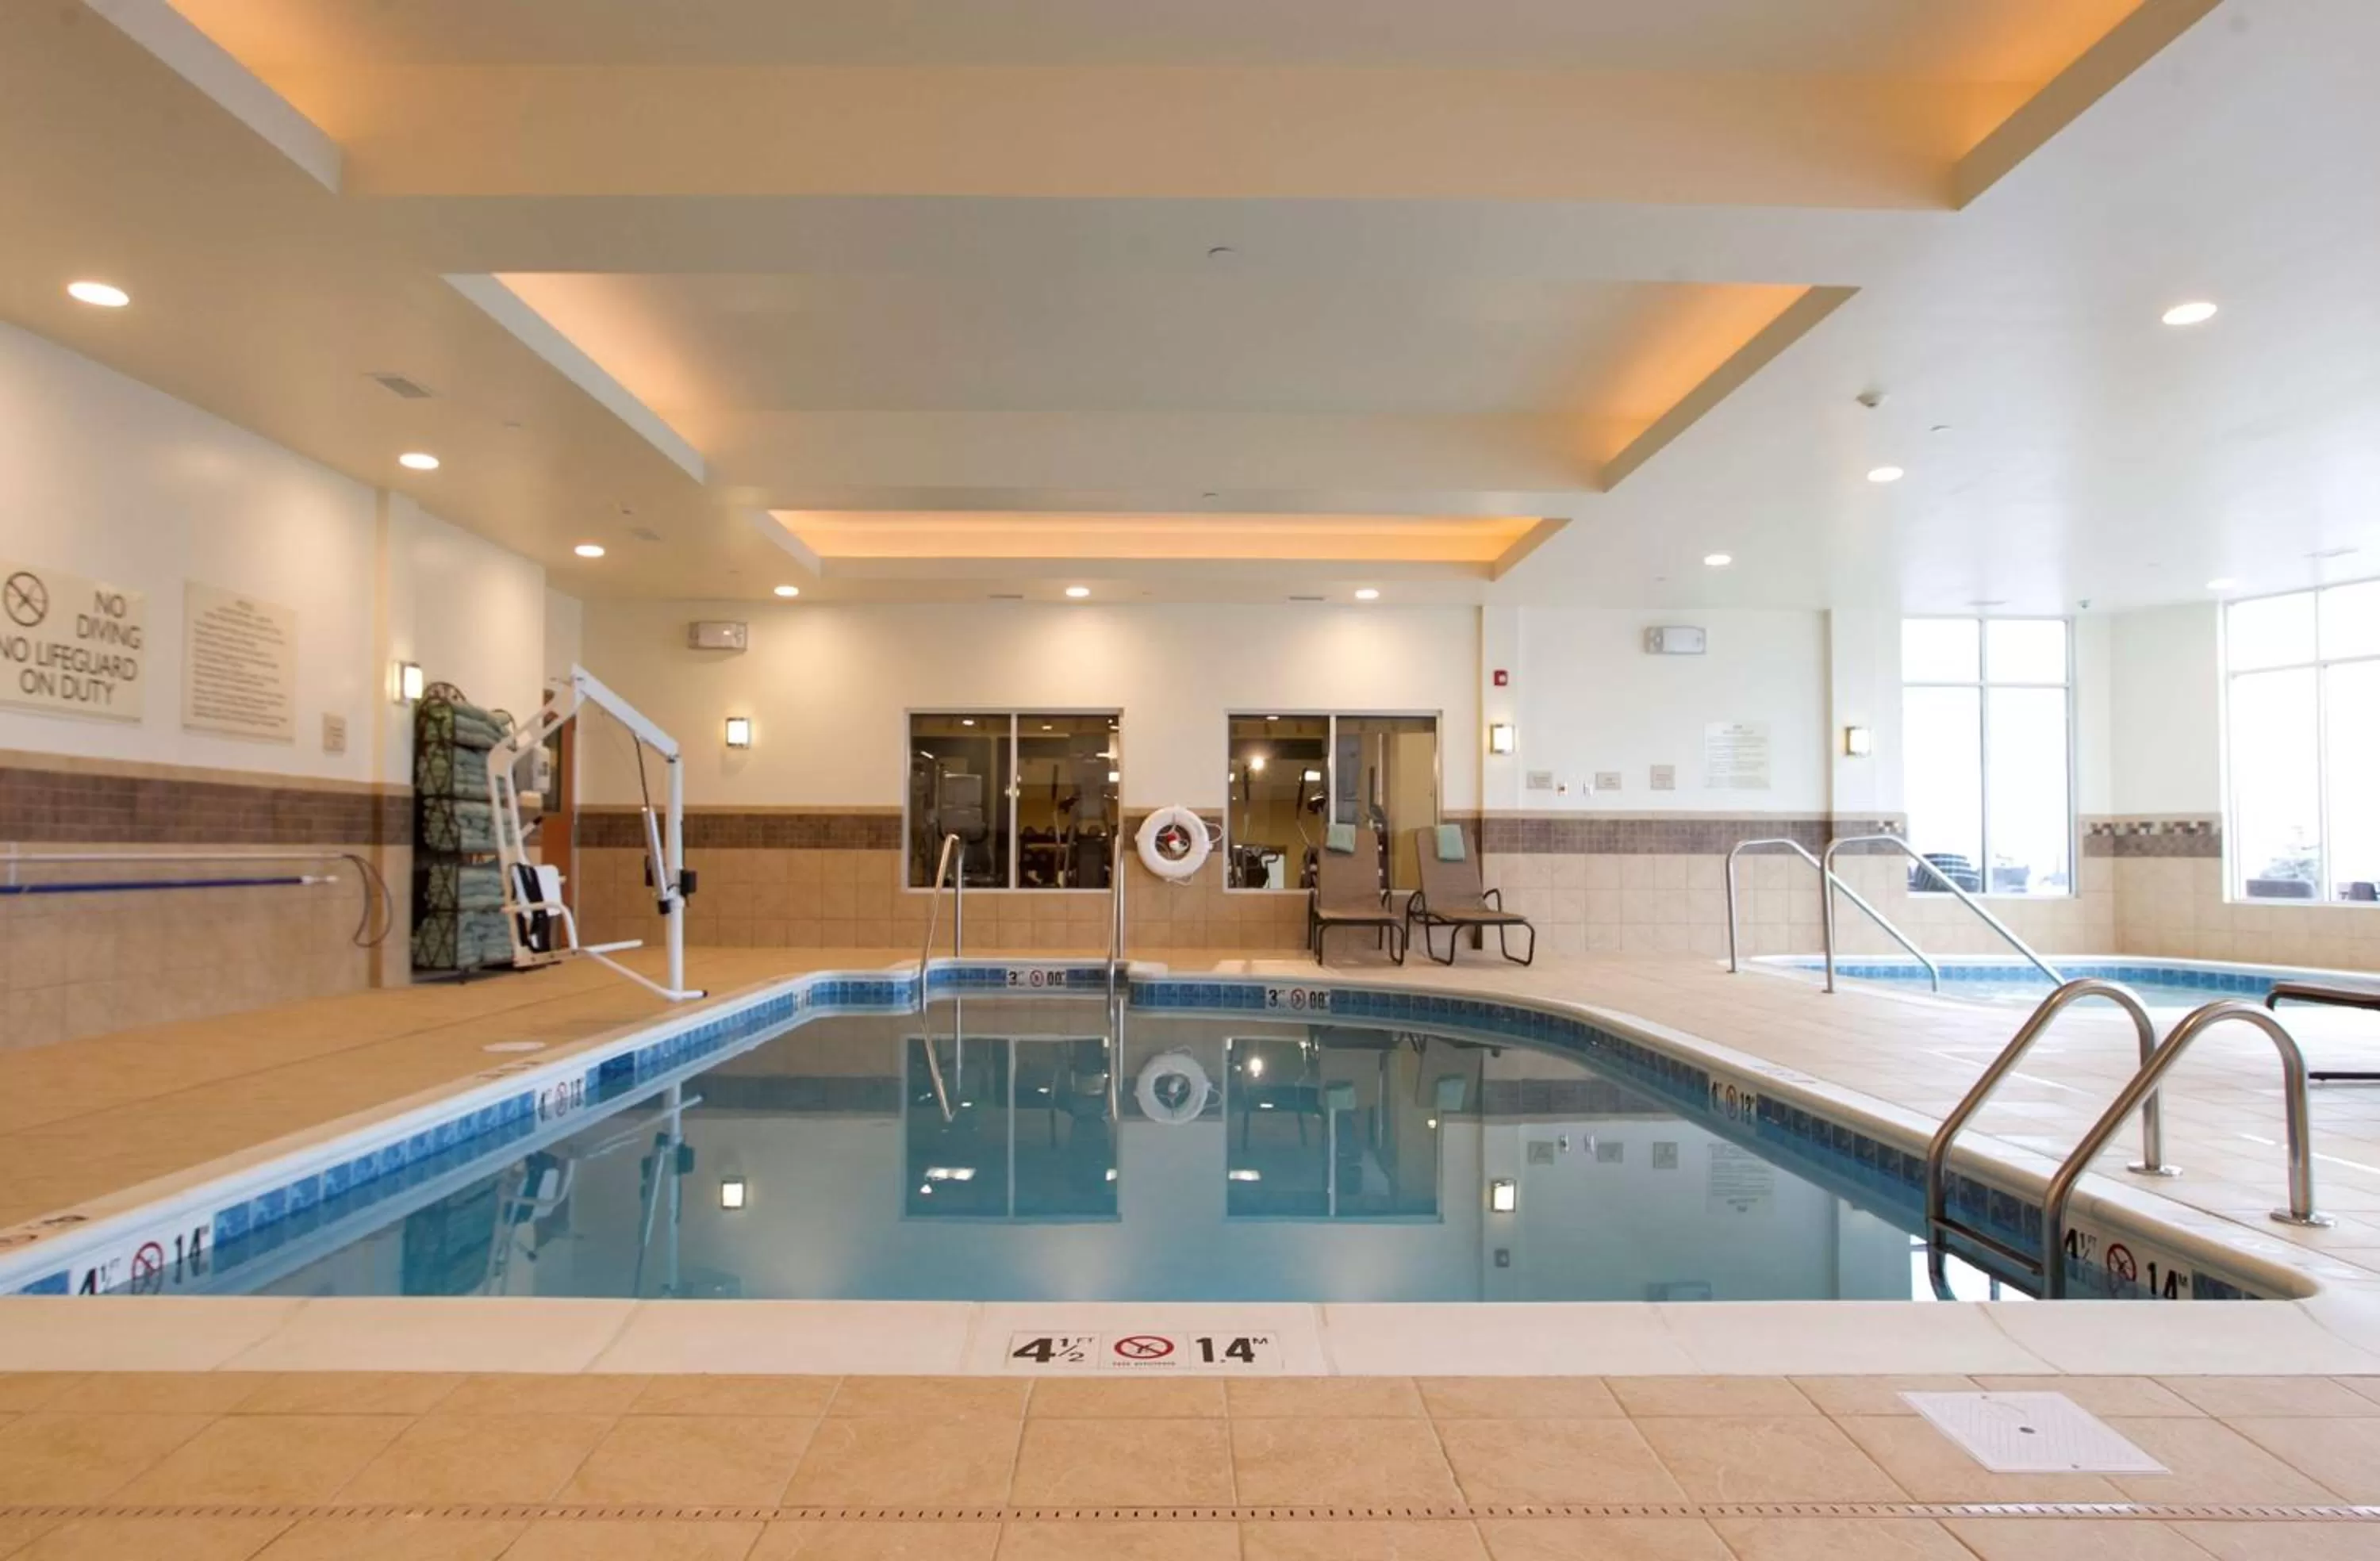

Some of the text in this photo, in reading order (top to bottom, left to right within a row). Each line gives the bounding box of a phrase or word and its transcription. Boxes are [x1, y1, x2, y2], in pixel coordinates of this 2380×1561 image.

[94, 589, 127, 619] NO
[76, 613, 142, 650] DIVING
[0, 635, 139, 682] NO LIFEGUARD
[19, 668, 116, 705] ON DUTY
